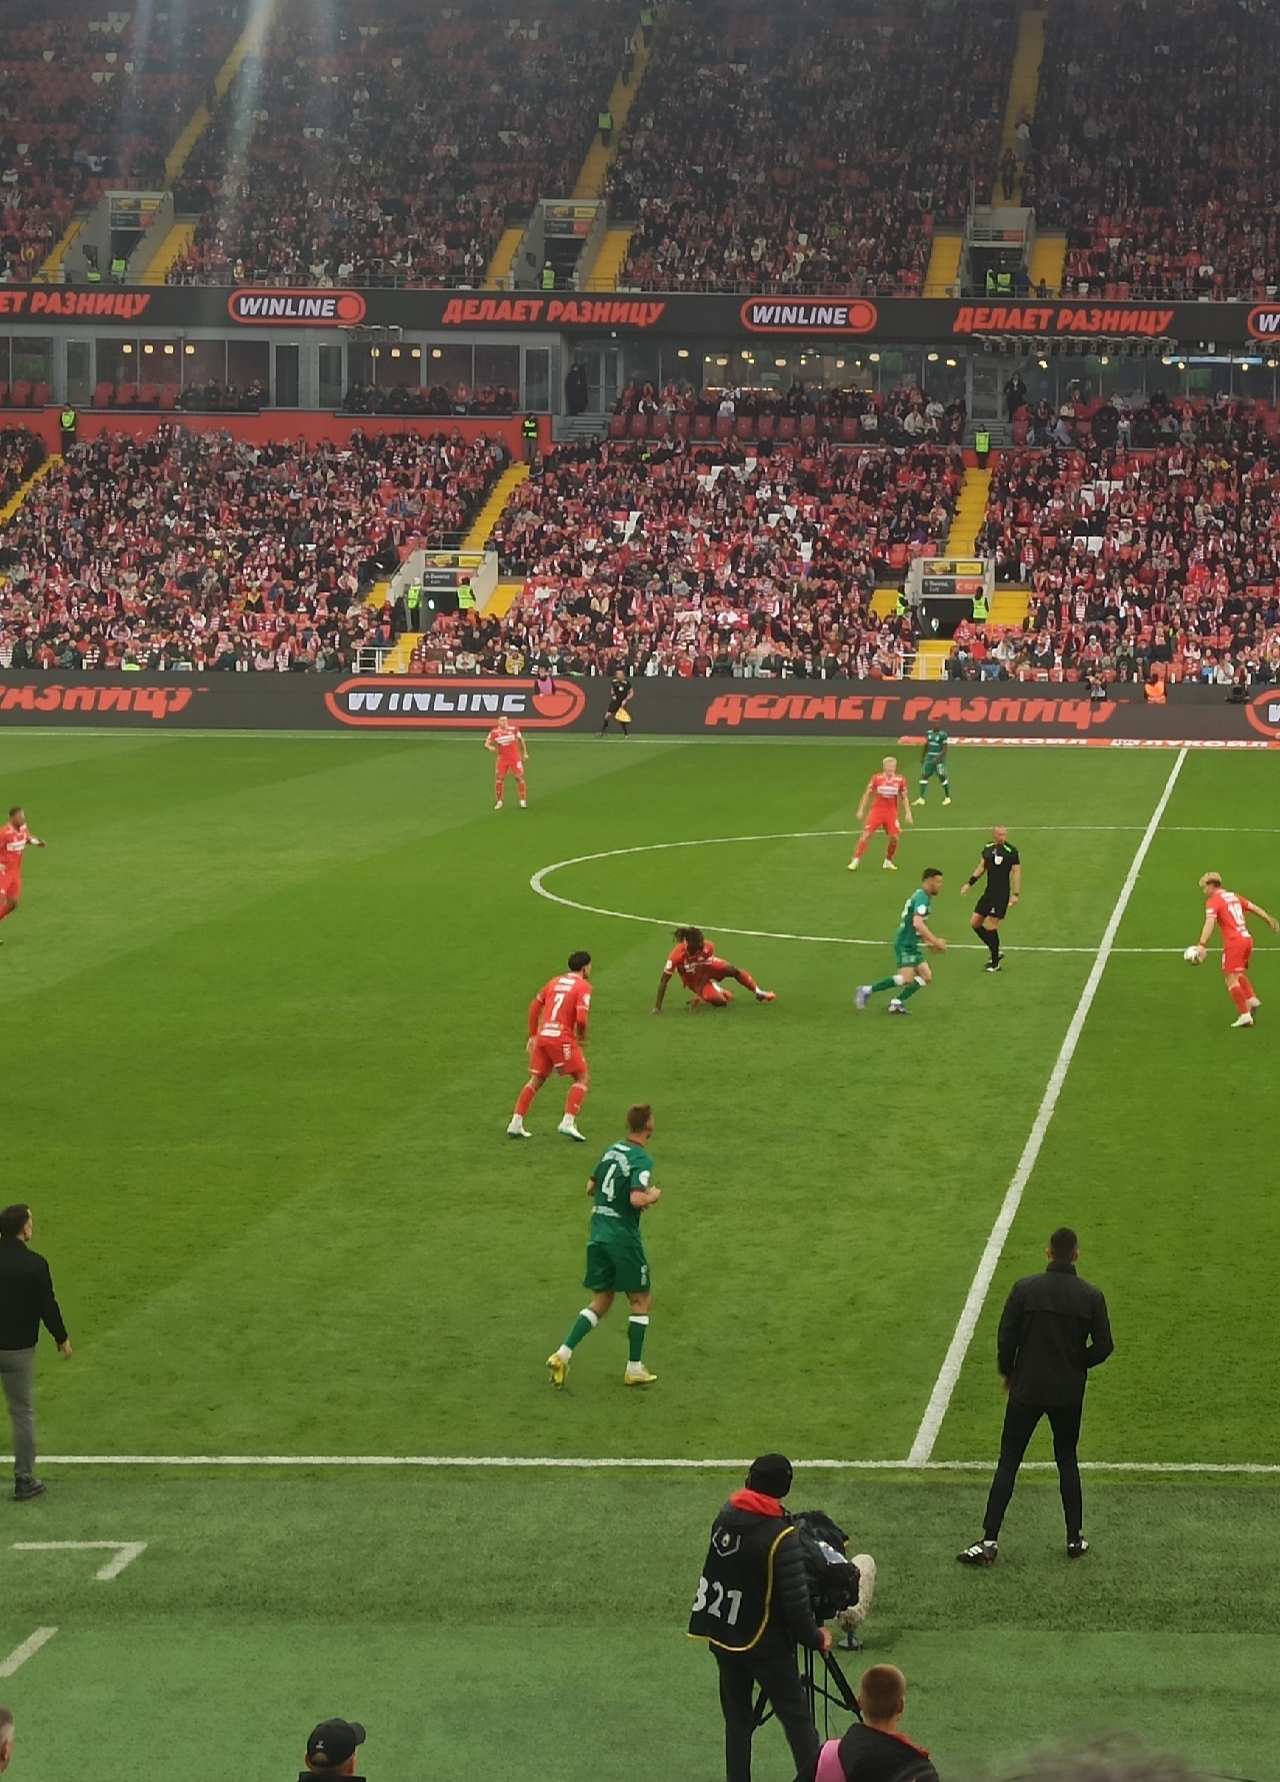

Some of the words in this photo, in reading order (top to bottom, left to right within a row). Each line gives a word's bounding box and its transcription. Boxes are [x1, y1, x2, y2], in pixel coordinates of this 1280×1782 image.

[30, 291, 151, 319] РАЗНИЦУ
[240, 297, 336, 317] WINLINE
[442, 298, 544, 324] ДЕЛАЕТ
[545, 300, 665, 328] РАЗНИЦУ
[753, 305, 848, 325] WINLINE
[953, 306, 1054, 333] ДЕЛАЕТ
[1056, 308, 1174, 336] РАЗНИЦУ
[0, 685, 193, 720] АЗНИЦУ
[348, 692, 527, 713] WINLINE
[705, 694, 903, 727] ДЕЛАЕТ
[959, 737, 1088, 746] ЛУКОИЛ
[1141, 738, 1269, 748] ЛУКОИЛ
[550, 992, 566, 1022] 7
[601, 1163, 617, 1202] 4
